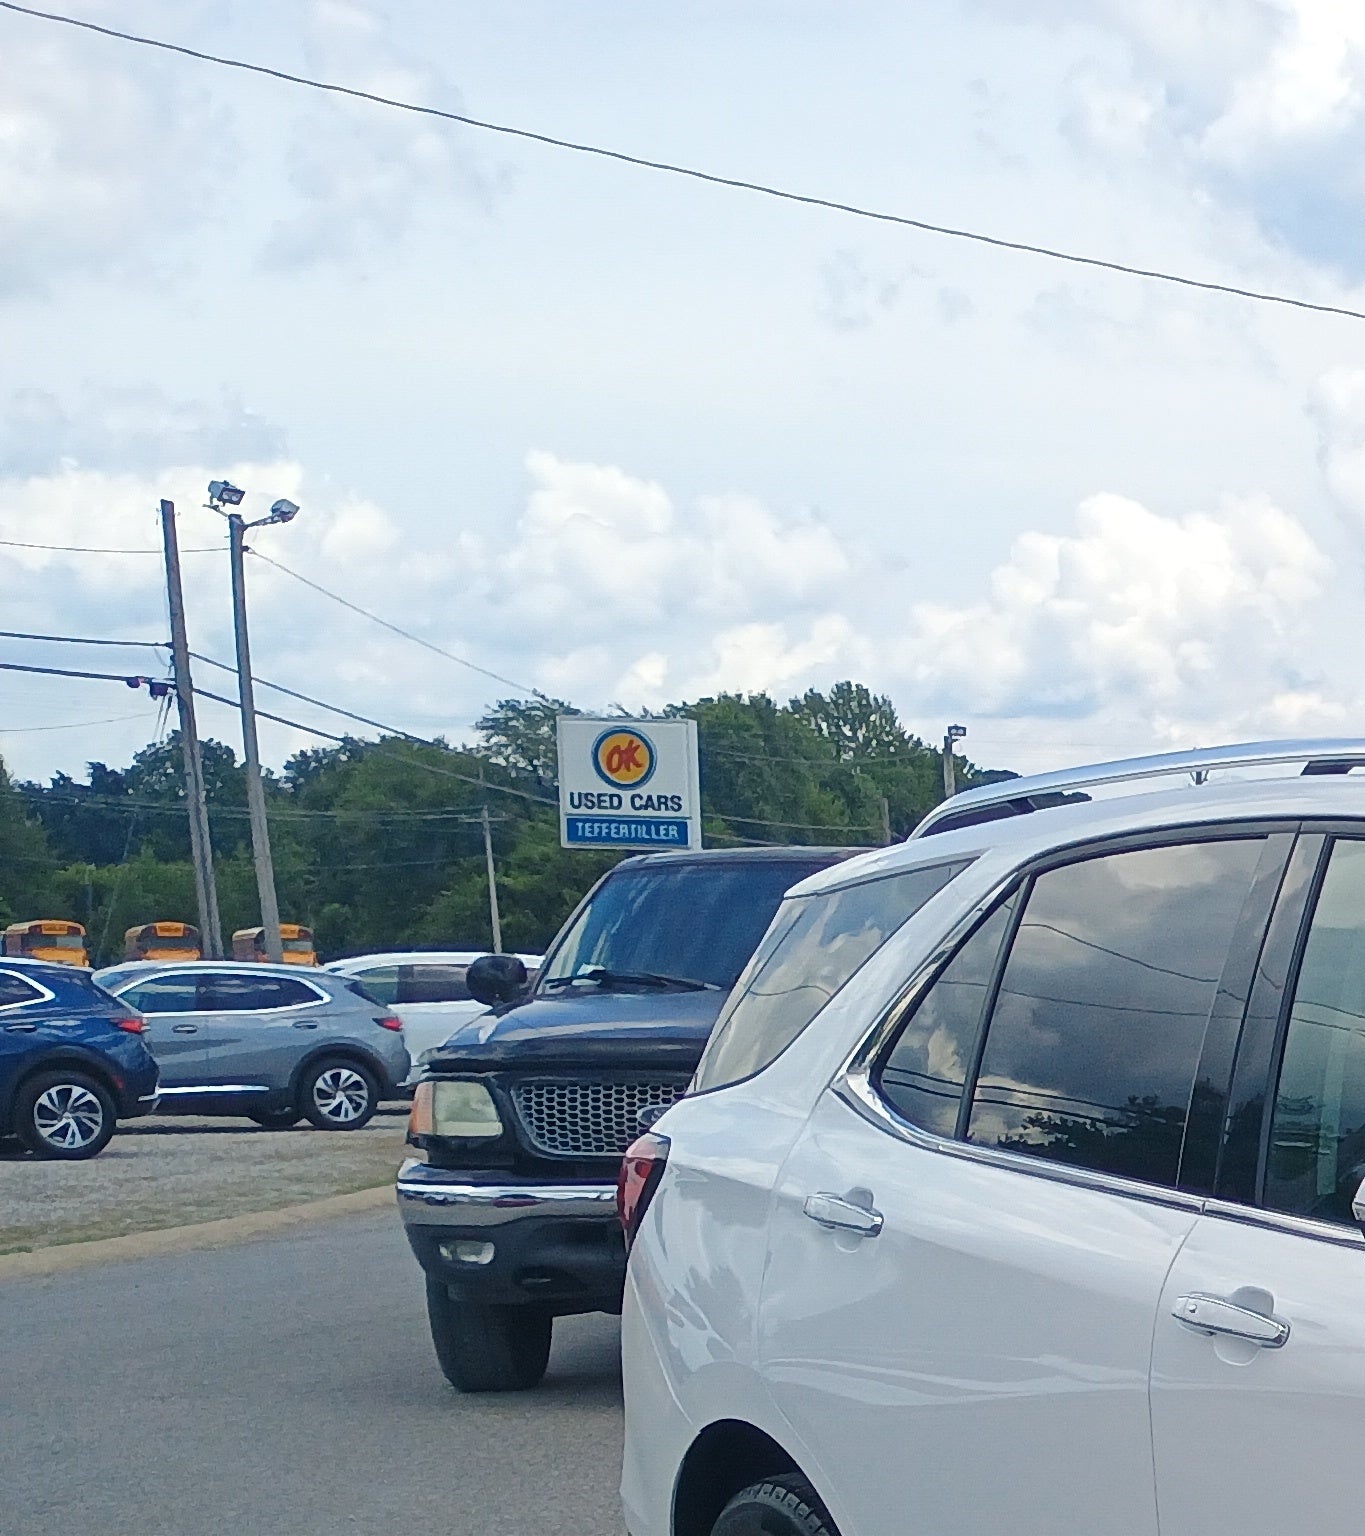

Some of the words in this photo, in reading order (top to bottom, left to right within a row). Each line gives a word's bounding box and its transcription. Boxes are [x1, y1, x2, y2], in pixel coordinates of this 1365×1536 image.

[605, 739, 643, 773] OK
[569, 791, 623, 811] USED
[630, 793, 683, 813] CARS
